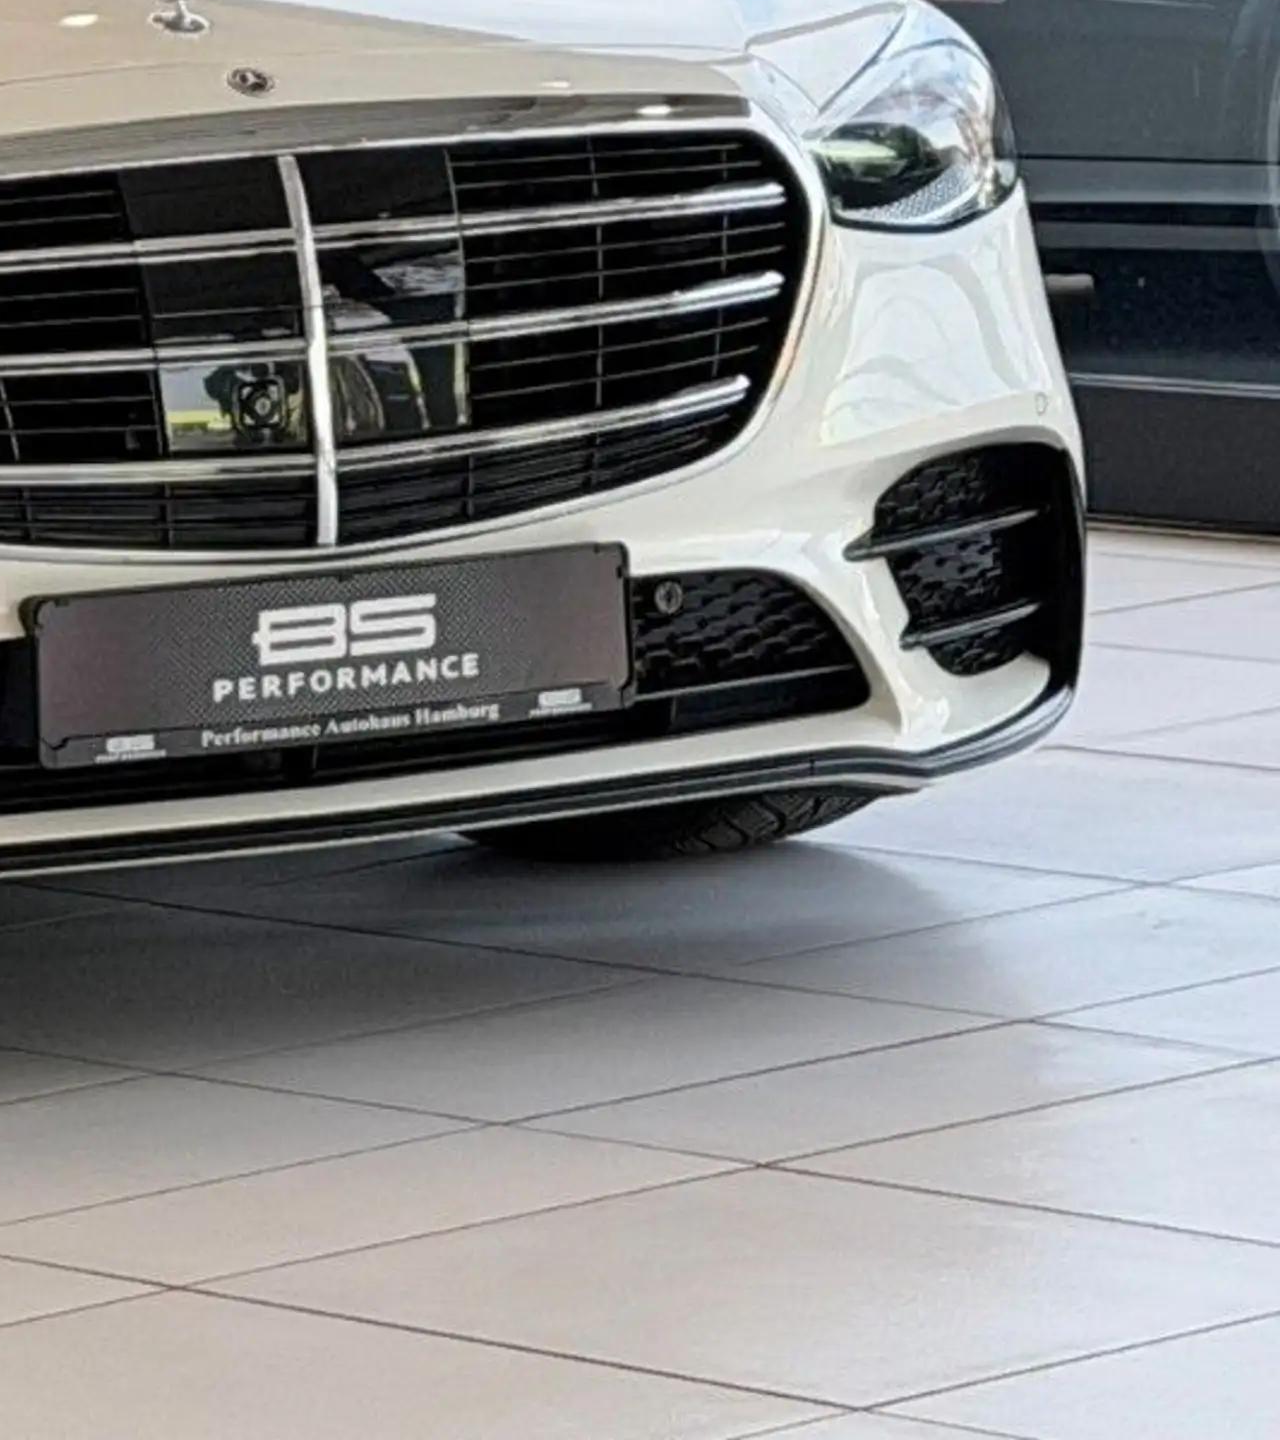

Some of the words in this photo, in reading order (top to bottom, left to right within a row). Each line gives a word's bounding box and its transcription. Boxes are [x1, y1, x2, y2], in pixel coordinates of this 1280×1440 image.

[212, 653, 480, 702] PERFORMANCE
[201, 722, 321, 748] Performance
[324, 712, 411, 734] Autohaus
[416, 703, 500, 725] Hamburg
